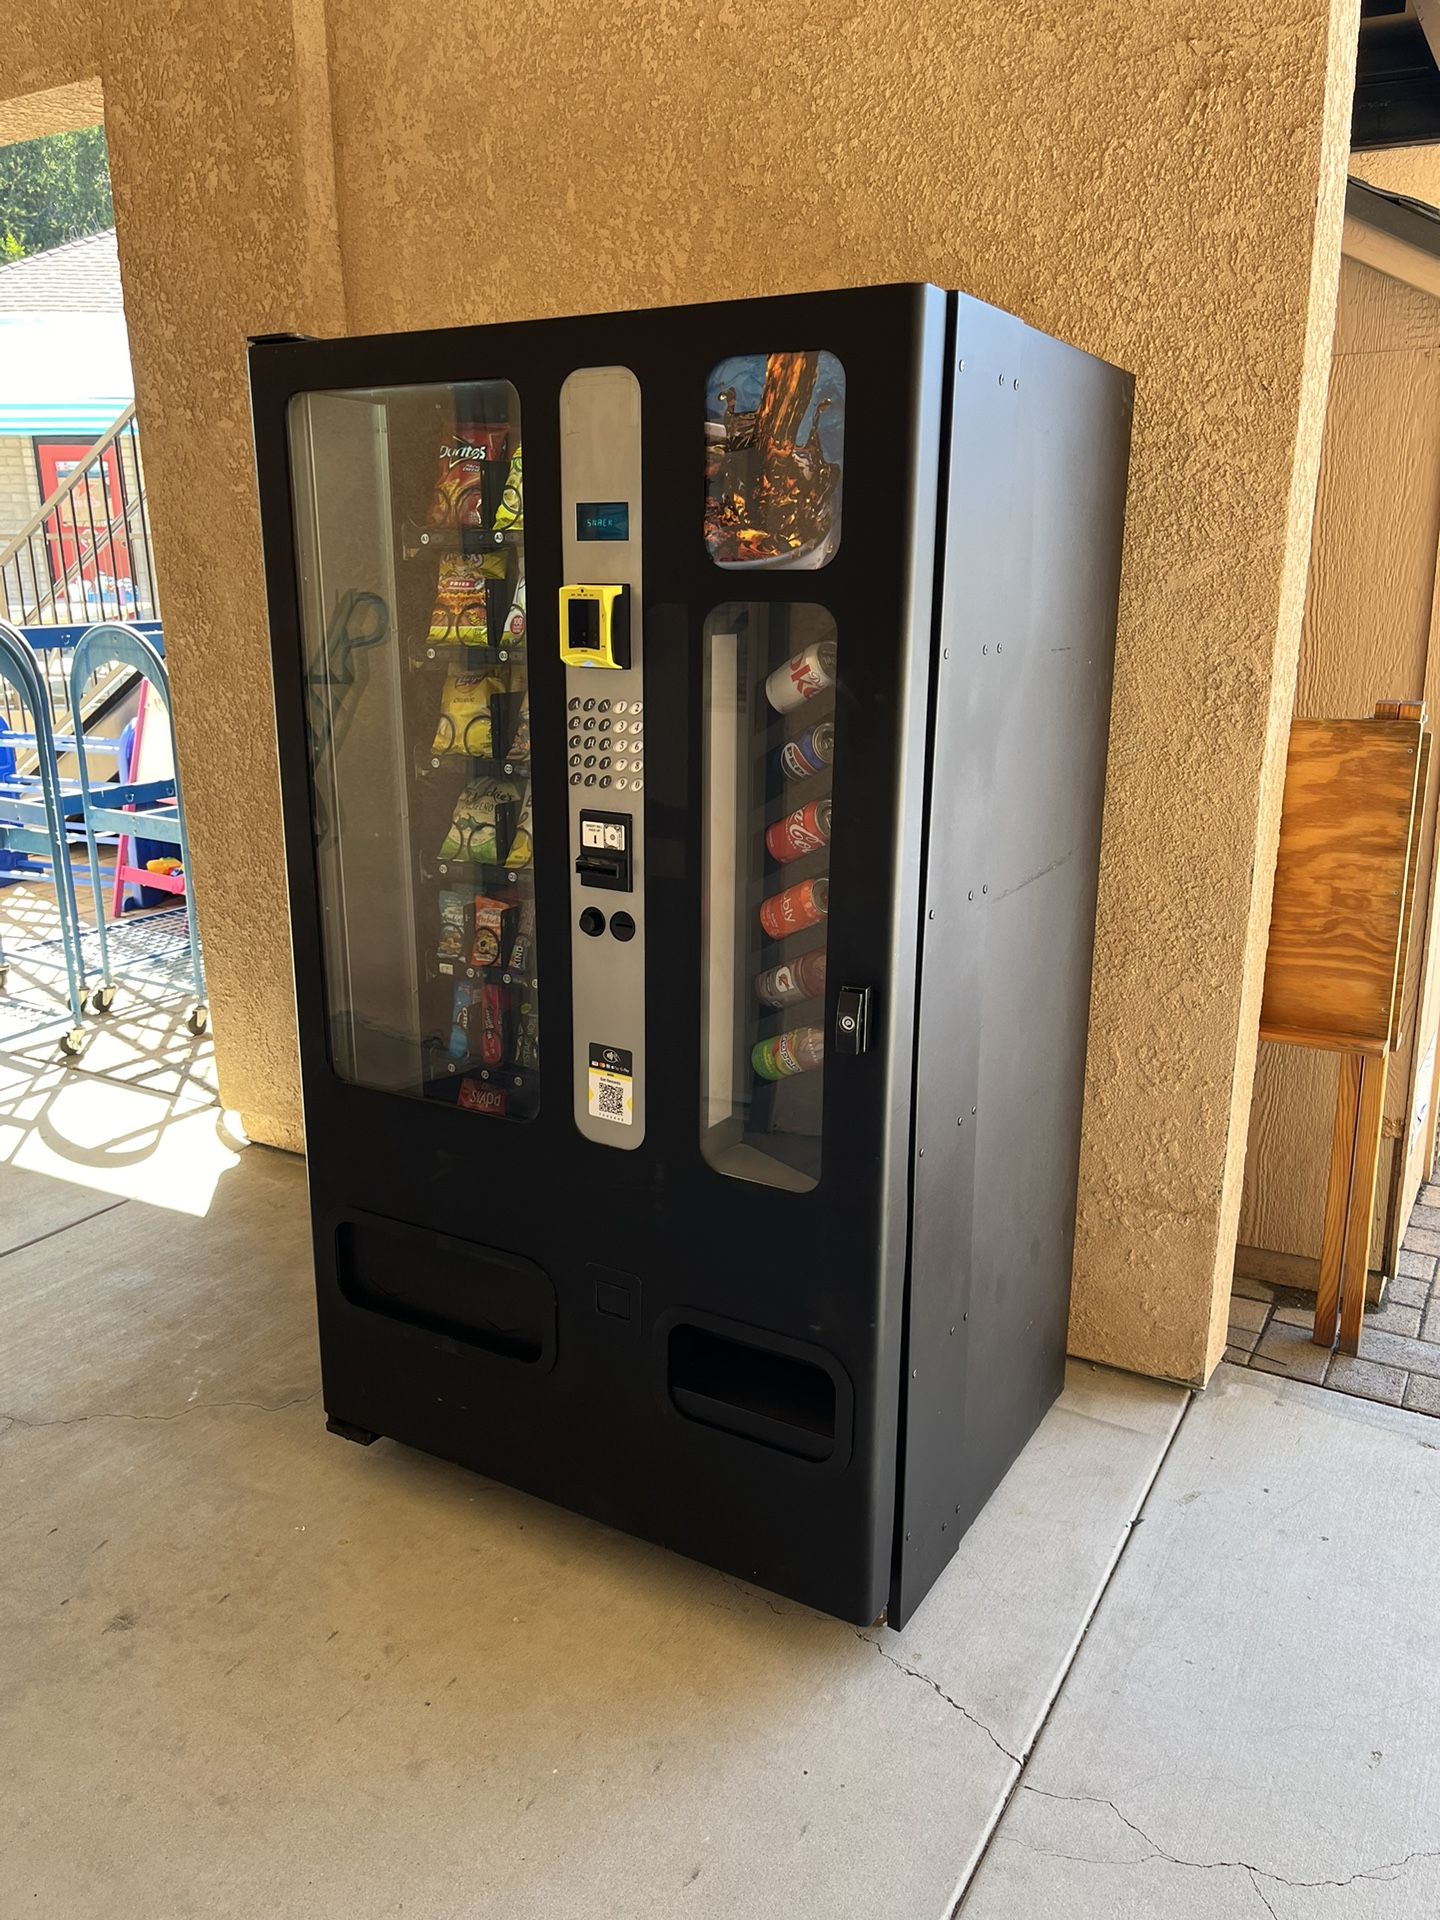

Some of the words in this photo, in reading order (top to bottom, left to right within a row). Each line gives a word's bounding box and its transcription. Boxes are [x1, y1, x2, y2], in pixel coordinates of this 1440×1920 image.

[440, 445, 486, 460] Doritos
[587, 519, 613, 527] SNACK
[513, 946, 523, 968] KIND
